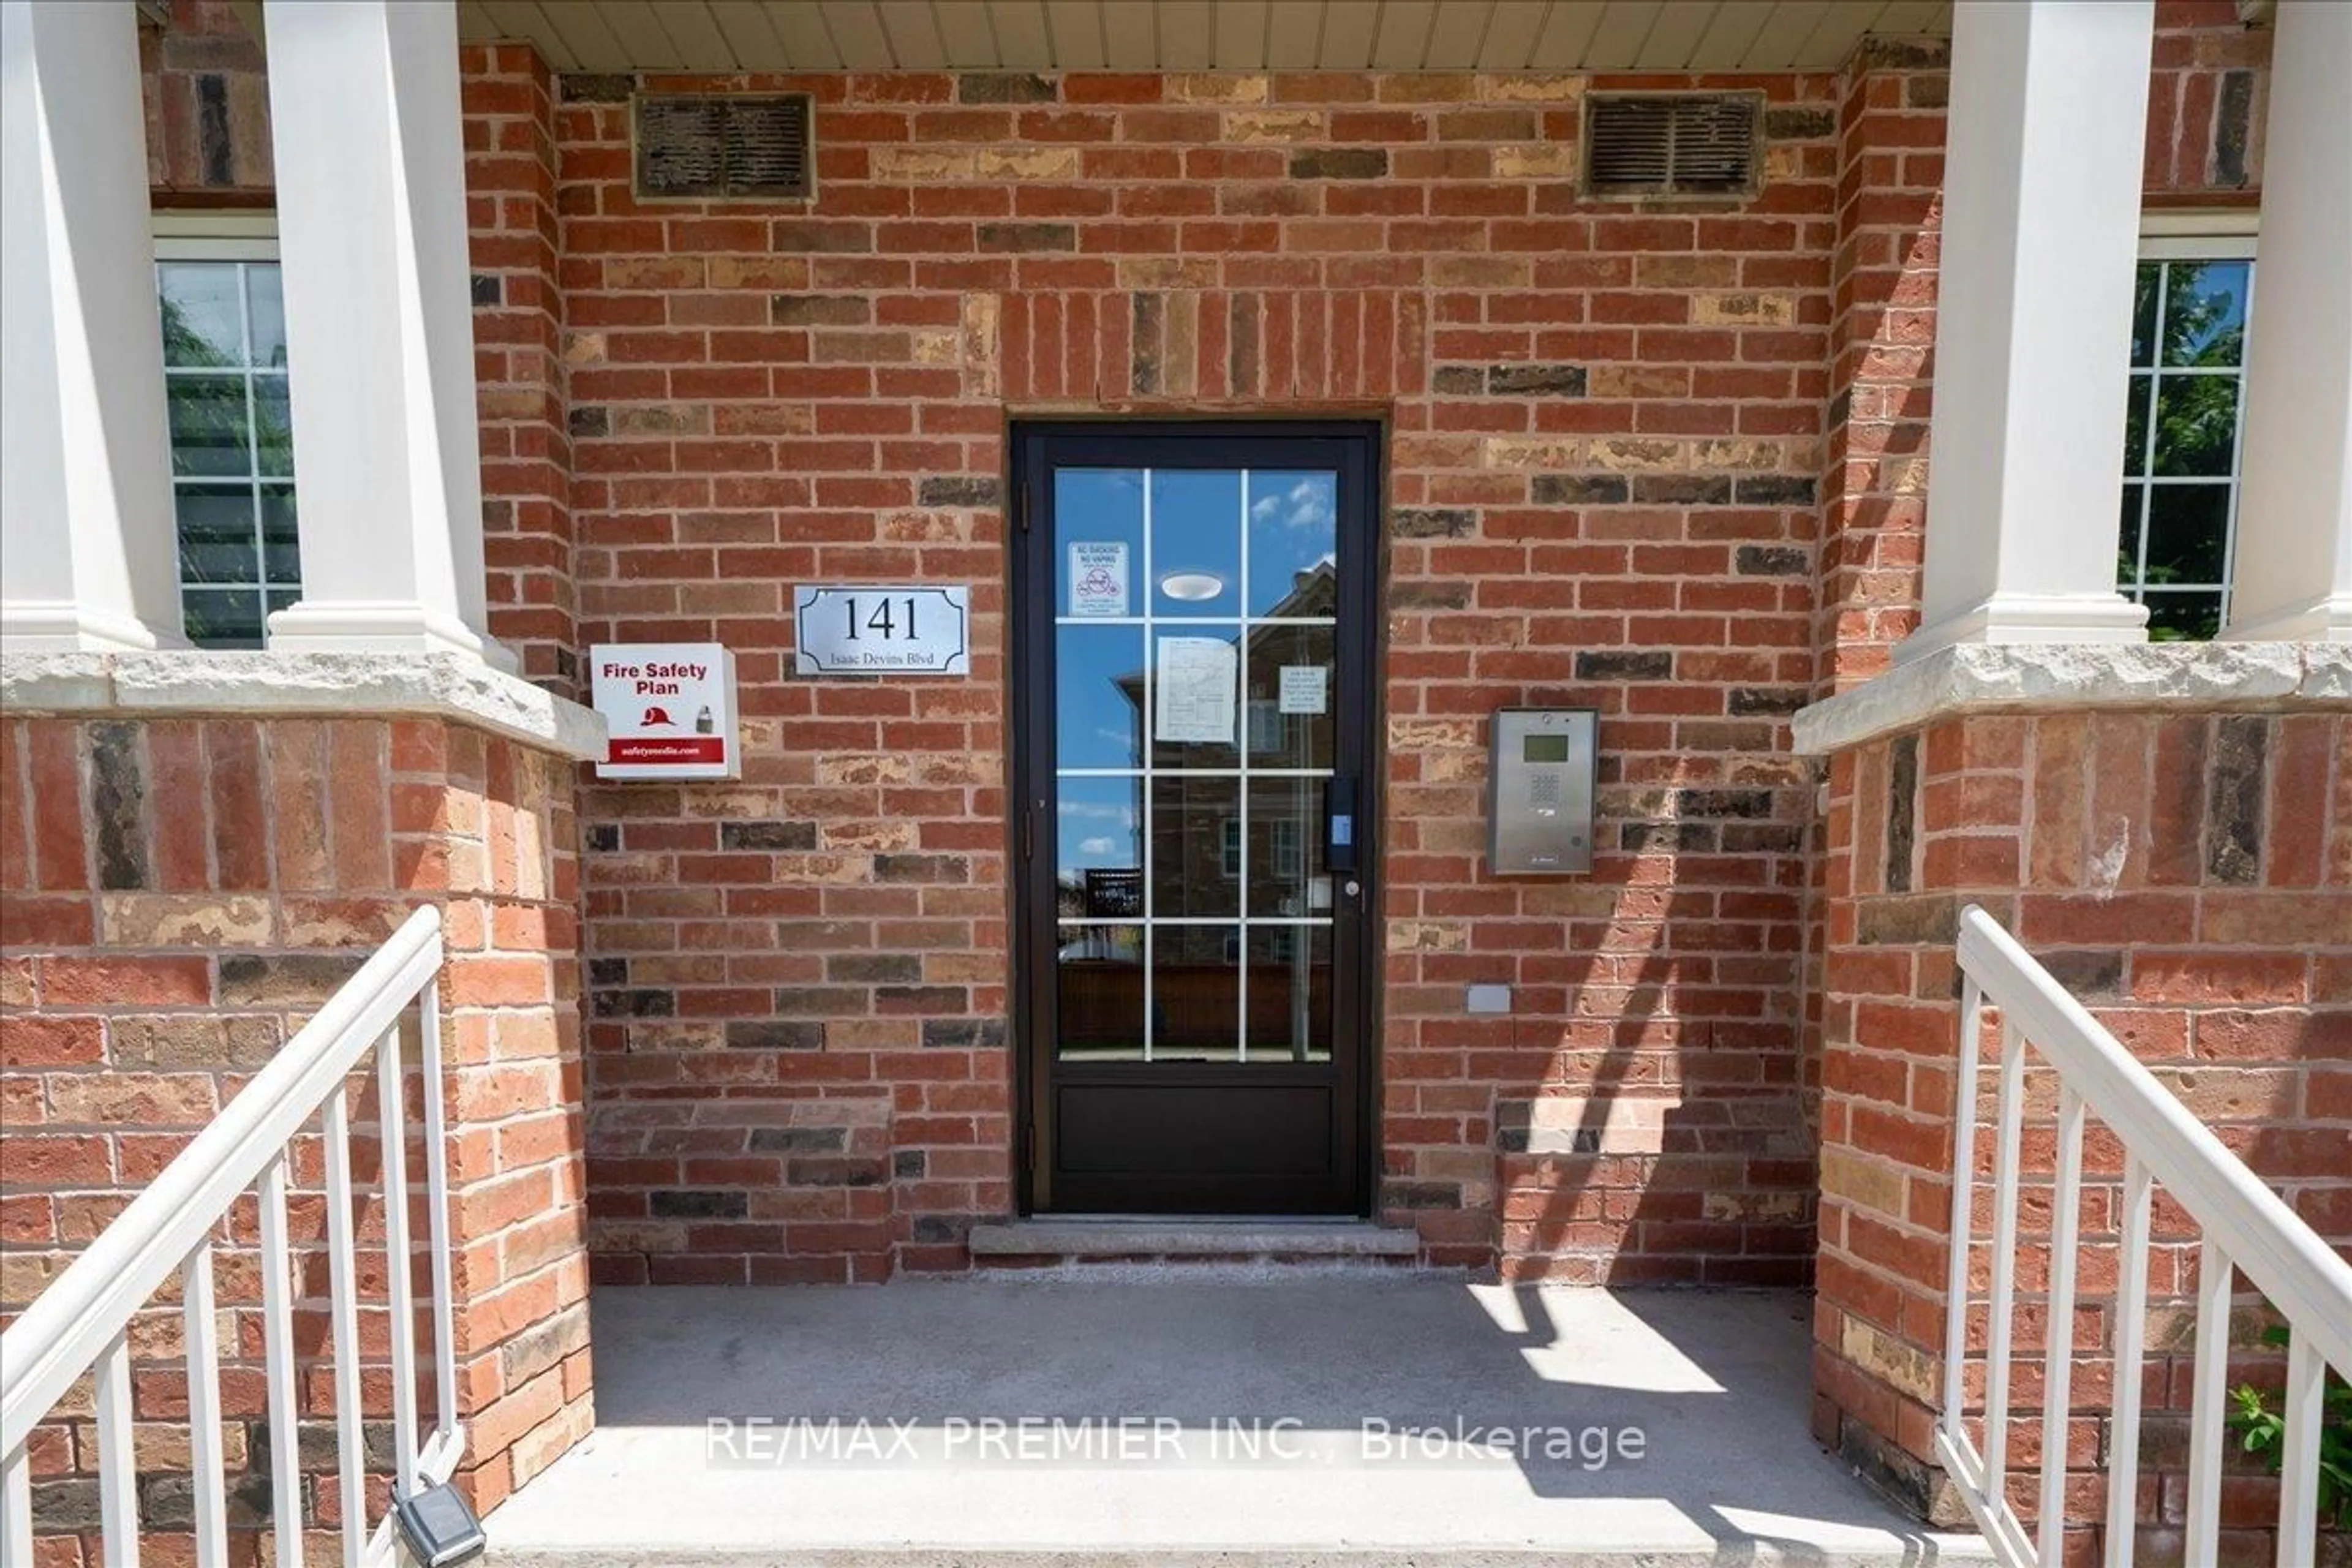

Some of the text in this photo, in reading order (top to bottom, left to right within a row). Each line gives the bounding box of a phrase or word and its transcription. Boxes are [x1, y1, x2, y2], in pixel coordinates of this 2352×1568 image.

[844, 597, 919, 639] 141
[831, 653, 934, 665] Isaac Devins Blvd
[603, 663, 706, 680] Fire Safety
[636, 680, 679, 695] Plan
